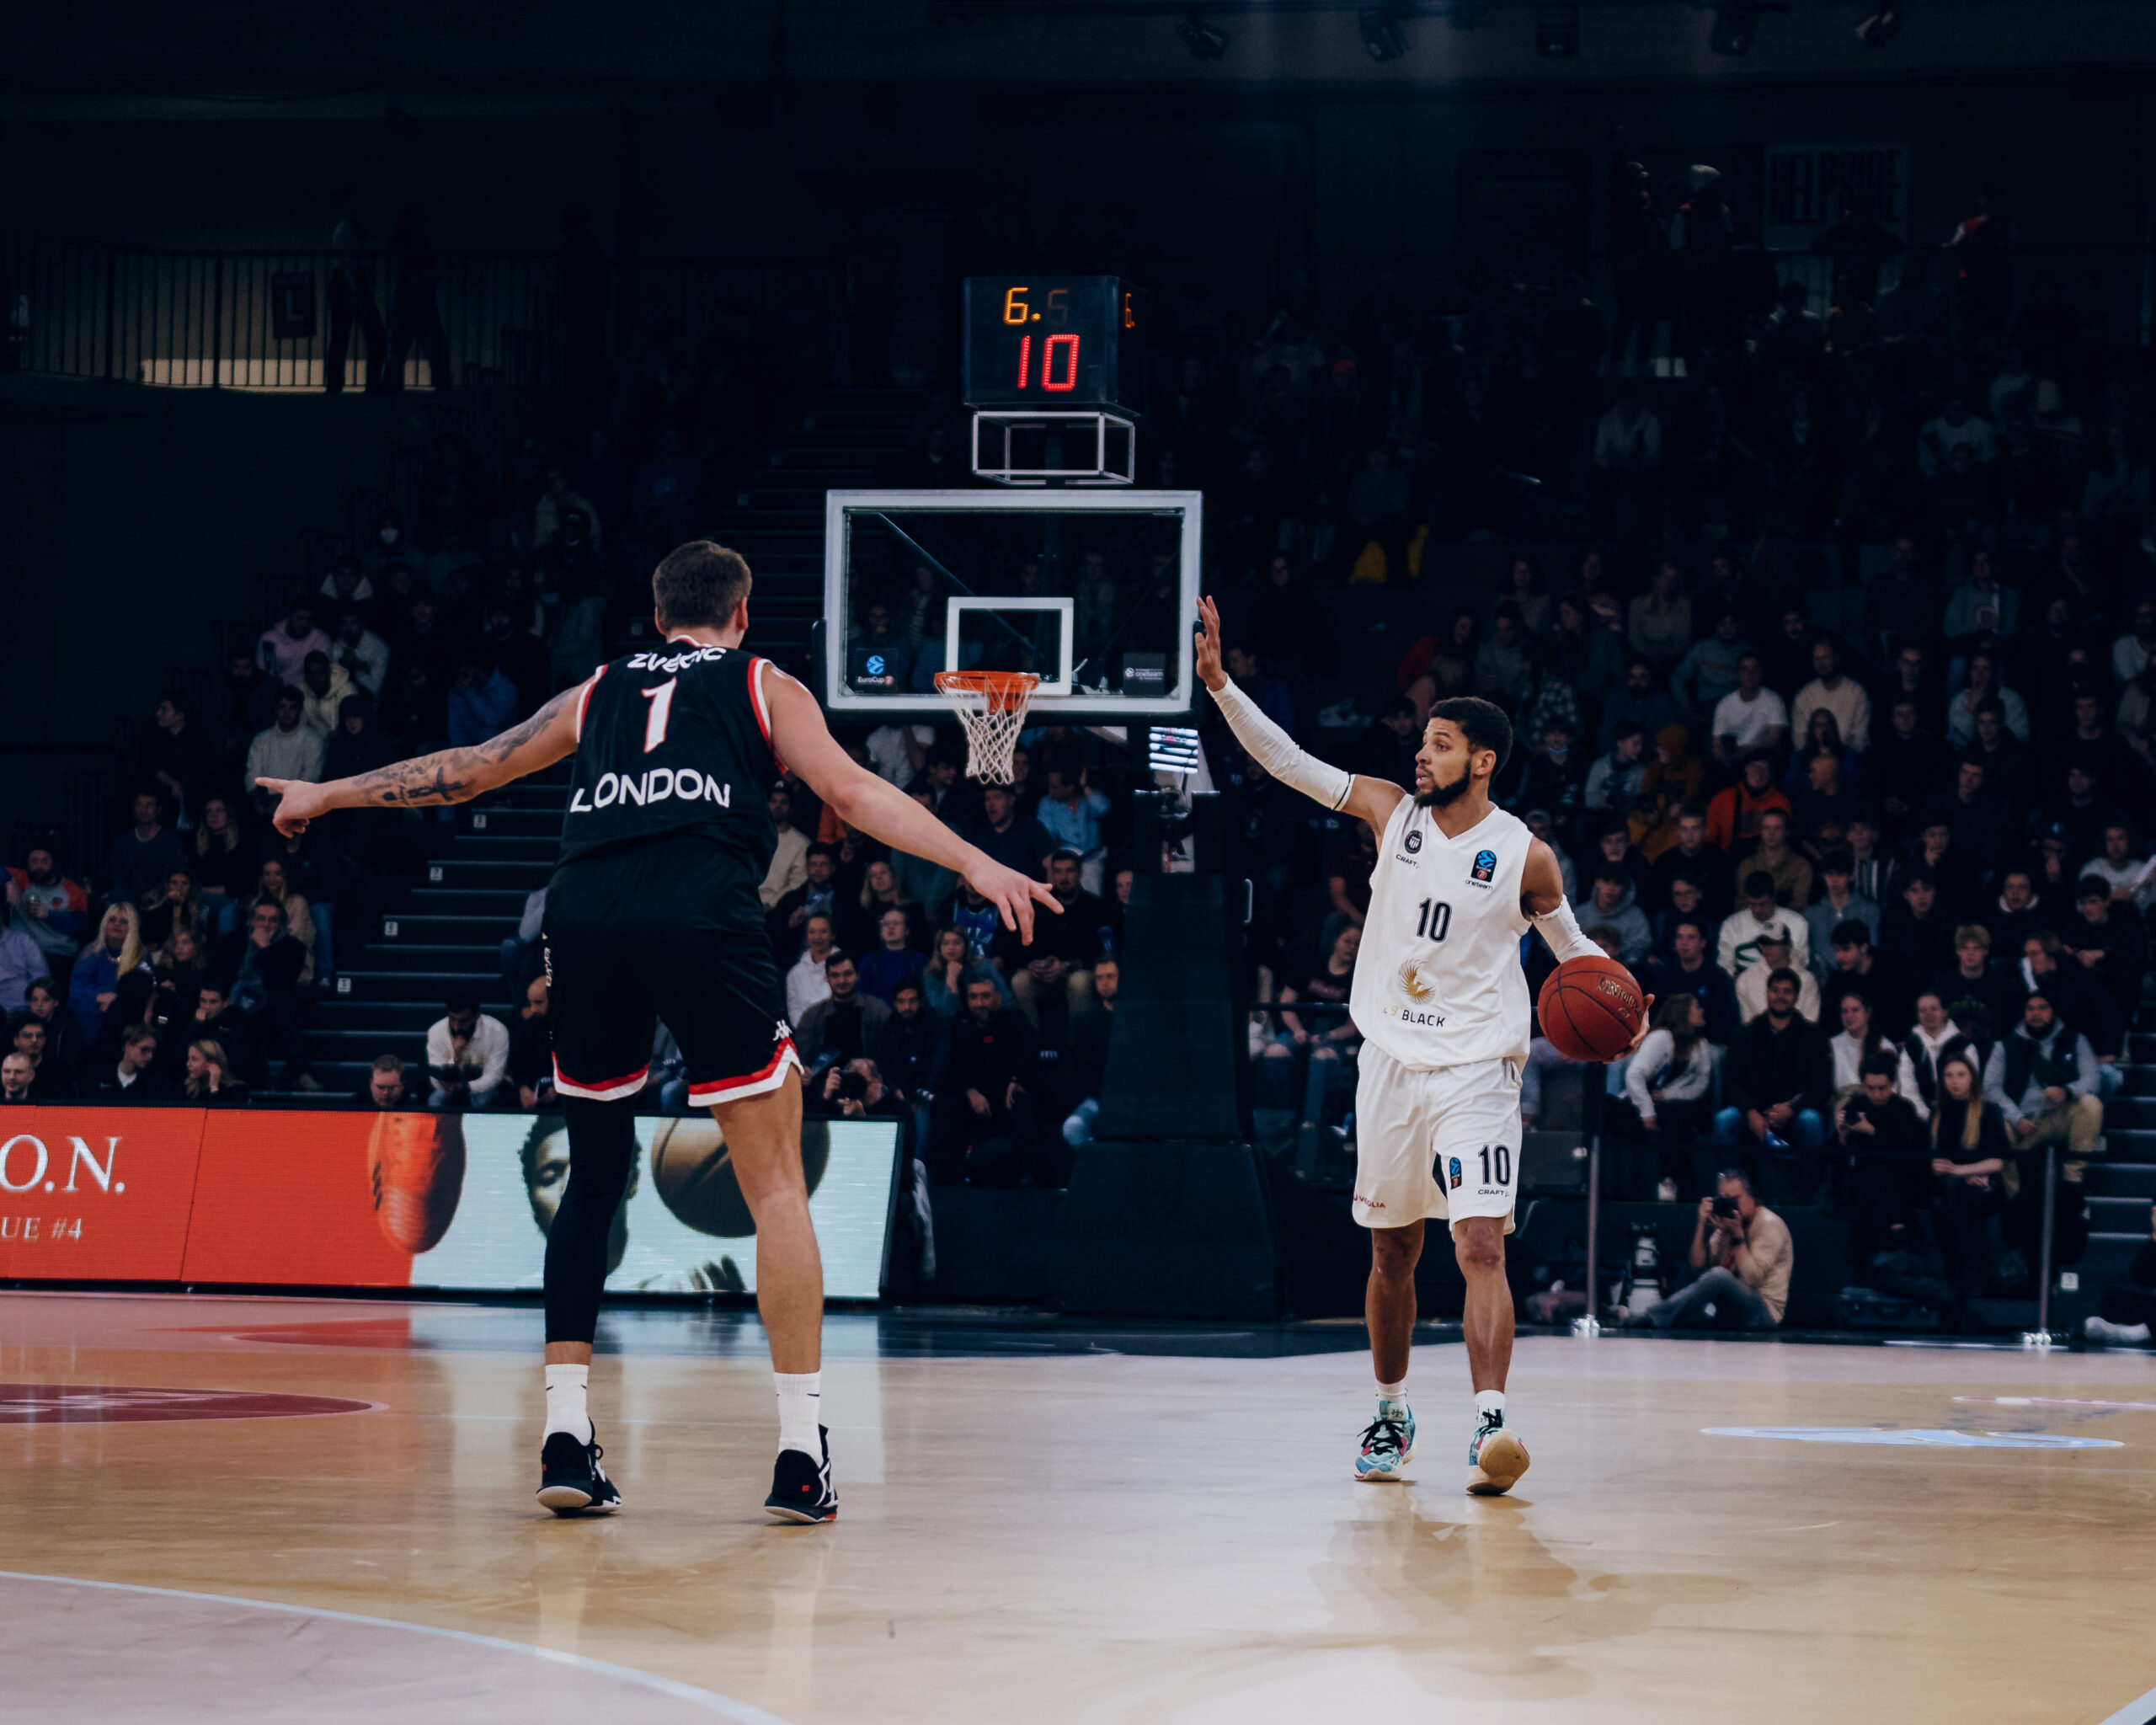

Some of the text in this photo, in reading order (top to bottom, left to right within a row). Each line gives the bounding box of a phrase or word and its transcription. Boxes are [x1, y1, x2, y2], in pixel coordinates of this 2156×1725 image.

[1017, 334, 1080, 392] 10
[857, 676, 884, 685] EuroCup
[641, 676, 677, 753] 1
[569, 767, 731, 813] LONDON
[1396, 853, 1417, 868] CRAFT
[1465, 879, 1494, 890] oneteam
[1417, 897, 1453, 943] 10
[1401, 1008, 1446, 1028] BLACK
[1478, 1144, 1511, 1187] 10
[1359, 1194, 1386, 1209] VEOLIA
[51, 1218, 82, 1242] #4
